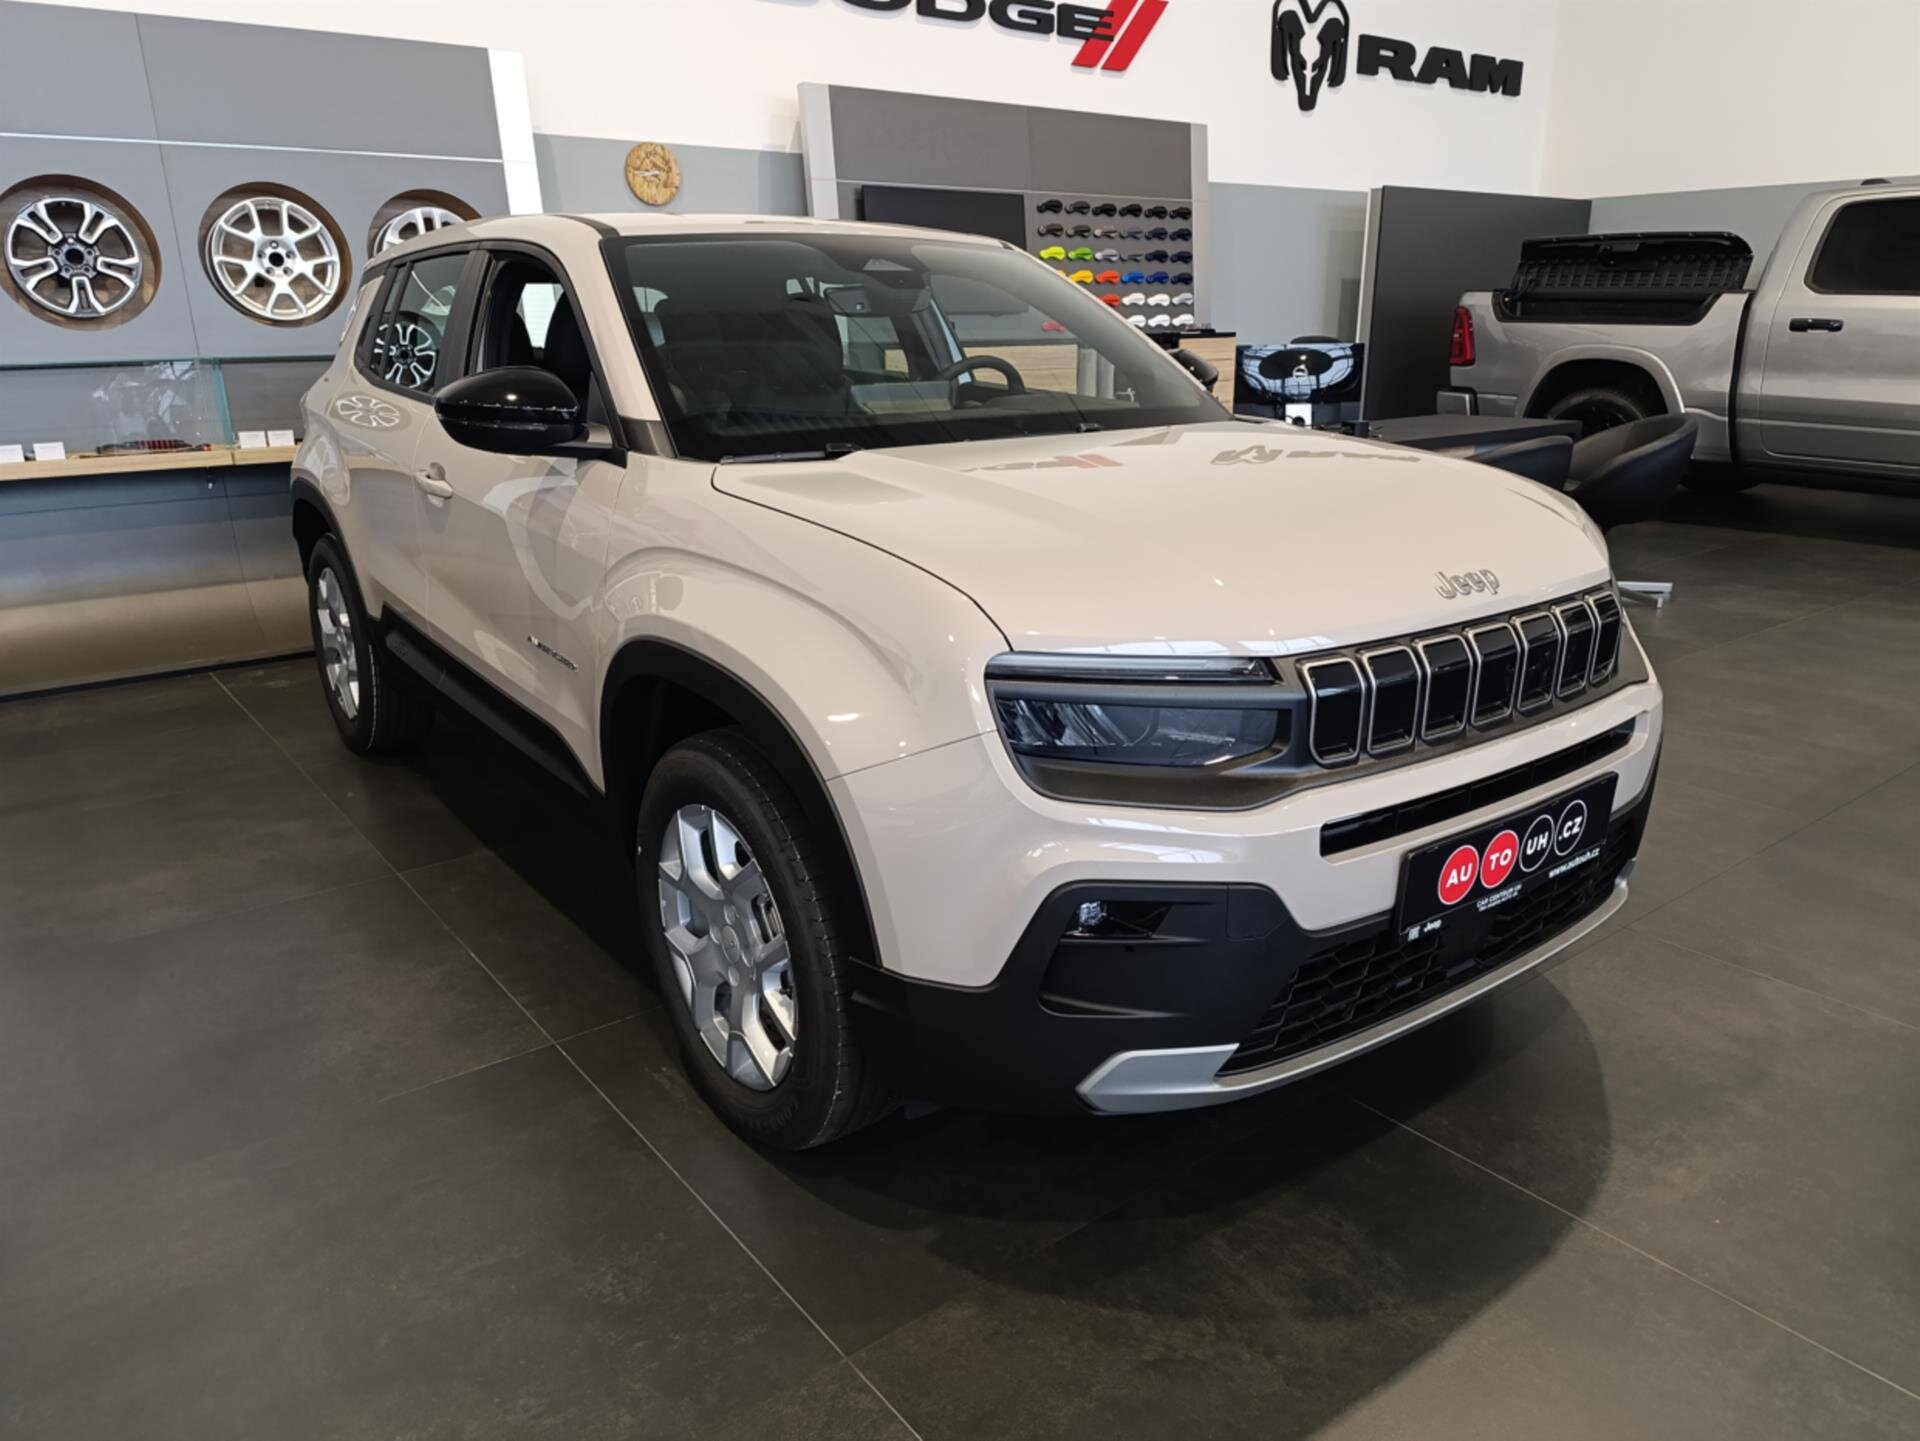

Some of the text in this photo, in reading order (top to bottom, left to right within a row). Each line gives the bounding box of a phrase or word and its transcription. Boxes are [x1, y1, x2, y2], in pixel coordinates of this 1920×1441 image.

[838, 0, 1114, 42] DGE
[1357, 33, 1524, 97] RAM
[1434, 569, 1500, 600] Jeep
[1445, 816, 1583, 888] AU TO UH .CZ
